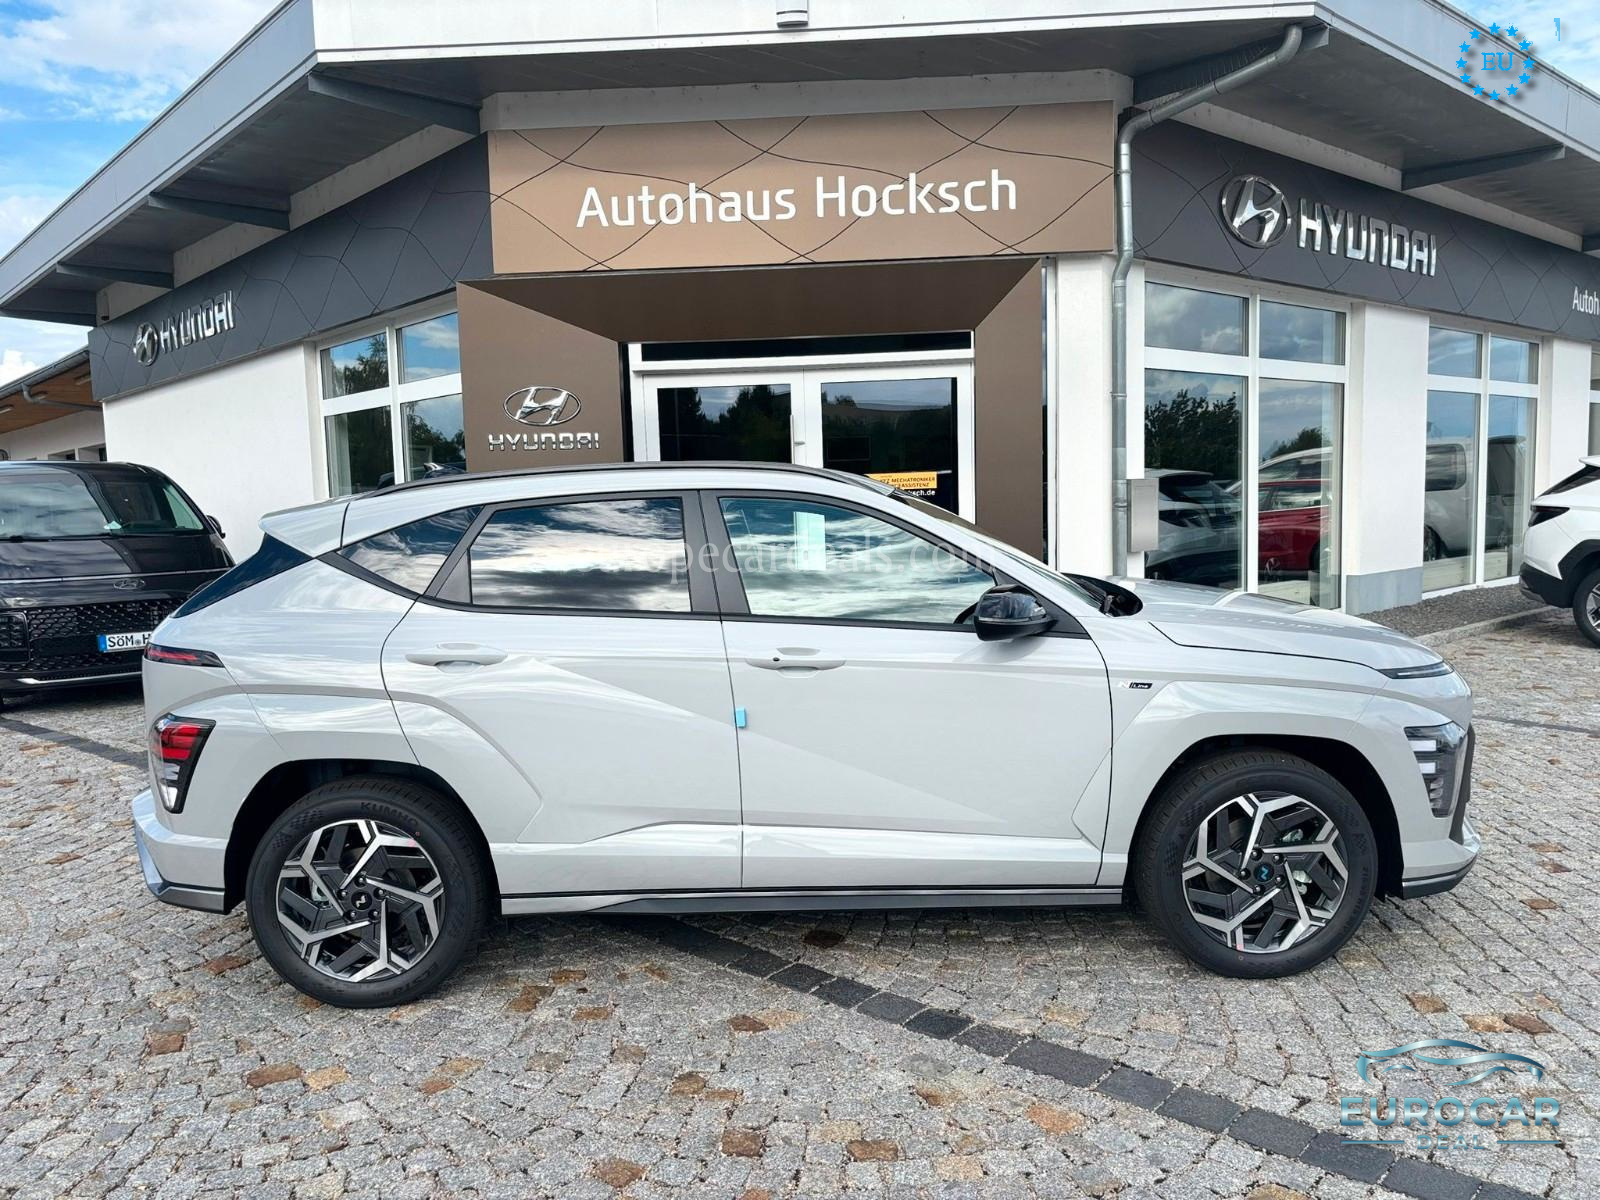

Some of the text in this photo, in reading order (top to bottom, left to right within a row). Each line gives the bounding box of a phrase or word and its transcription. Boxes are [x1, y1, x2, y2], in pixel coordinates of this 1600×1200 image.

[576, 169, 1017, 227] Autohaus Hocksch
[1299, 198, 1437, 277] HYUNDAI
[160, 289, 235, 354] HYUNDAI
[487, 432, 600, 452] HYUNDAI
